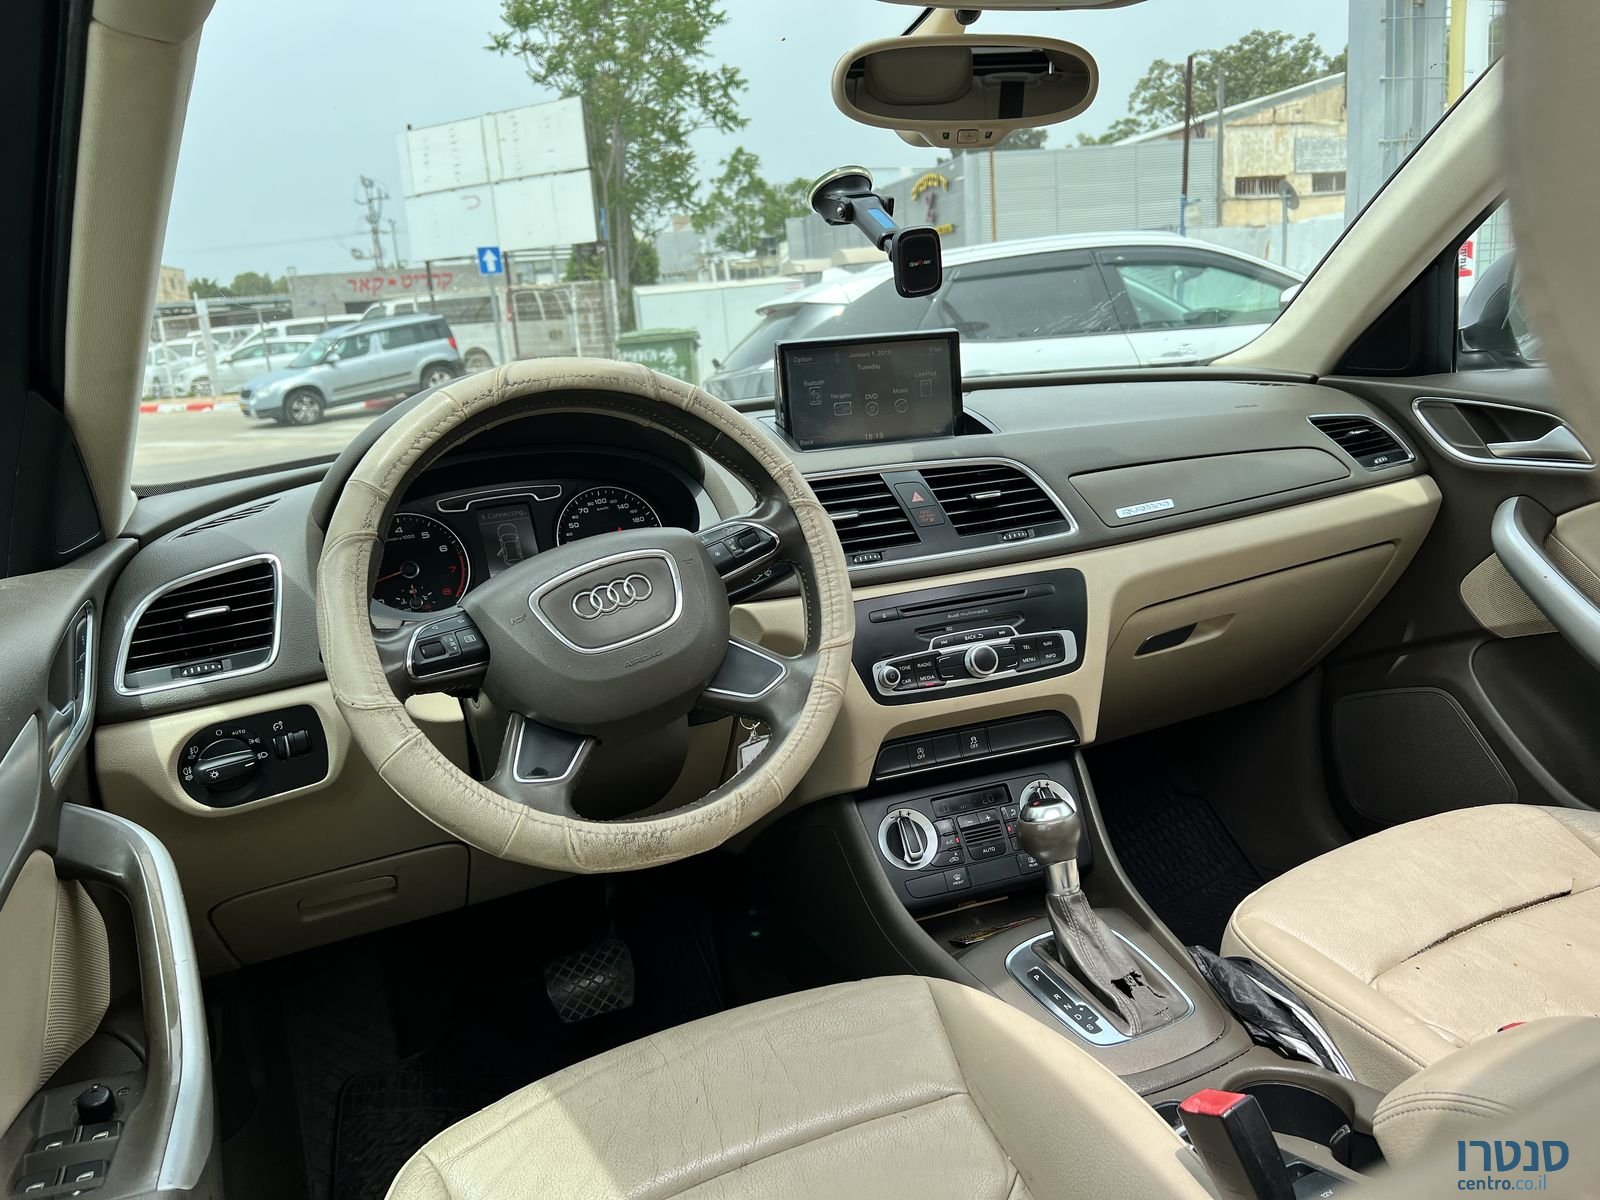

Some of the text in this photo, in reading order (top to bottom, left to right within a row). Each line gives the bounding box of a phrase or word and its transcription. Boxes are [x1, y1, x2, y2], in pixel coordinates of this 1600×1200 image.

[346, 275, 385, 296] קאר
[793, 355, 813, 364] Option
[857, 363, 881, 371] Tuesday
[594, 497, 607, 505] 100
[617, 502, 630, 510] 140
[568, 521, 580, 529] 50
[420, 531, 430, 539] 5
[438, 544, 448, 552] 6
[1022, 655, 1036, 663] MENU
[917, 660, 932, 668] RADIO
[919, 674, 936, 682] MEDIA
[231, 728, 246, 736] AUTO
[982, 846, 996, 854] AUTO
[1033, 974, 1040, 982] P
[1074, 1013, 1082, 1021] D
